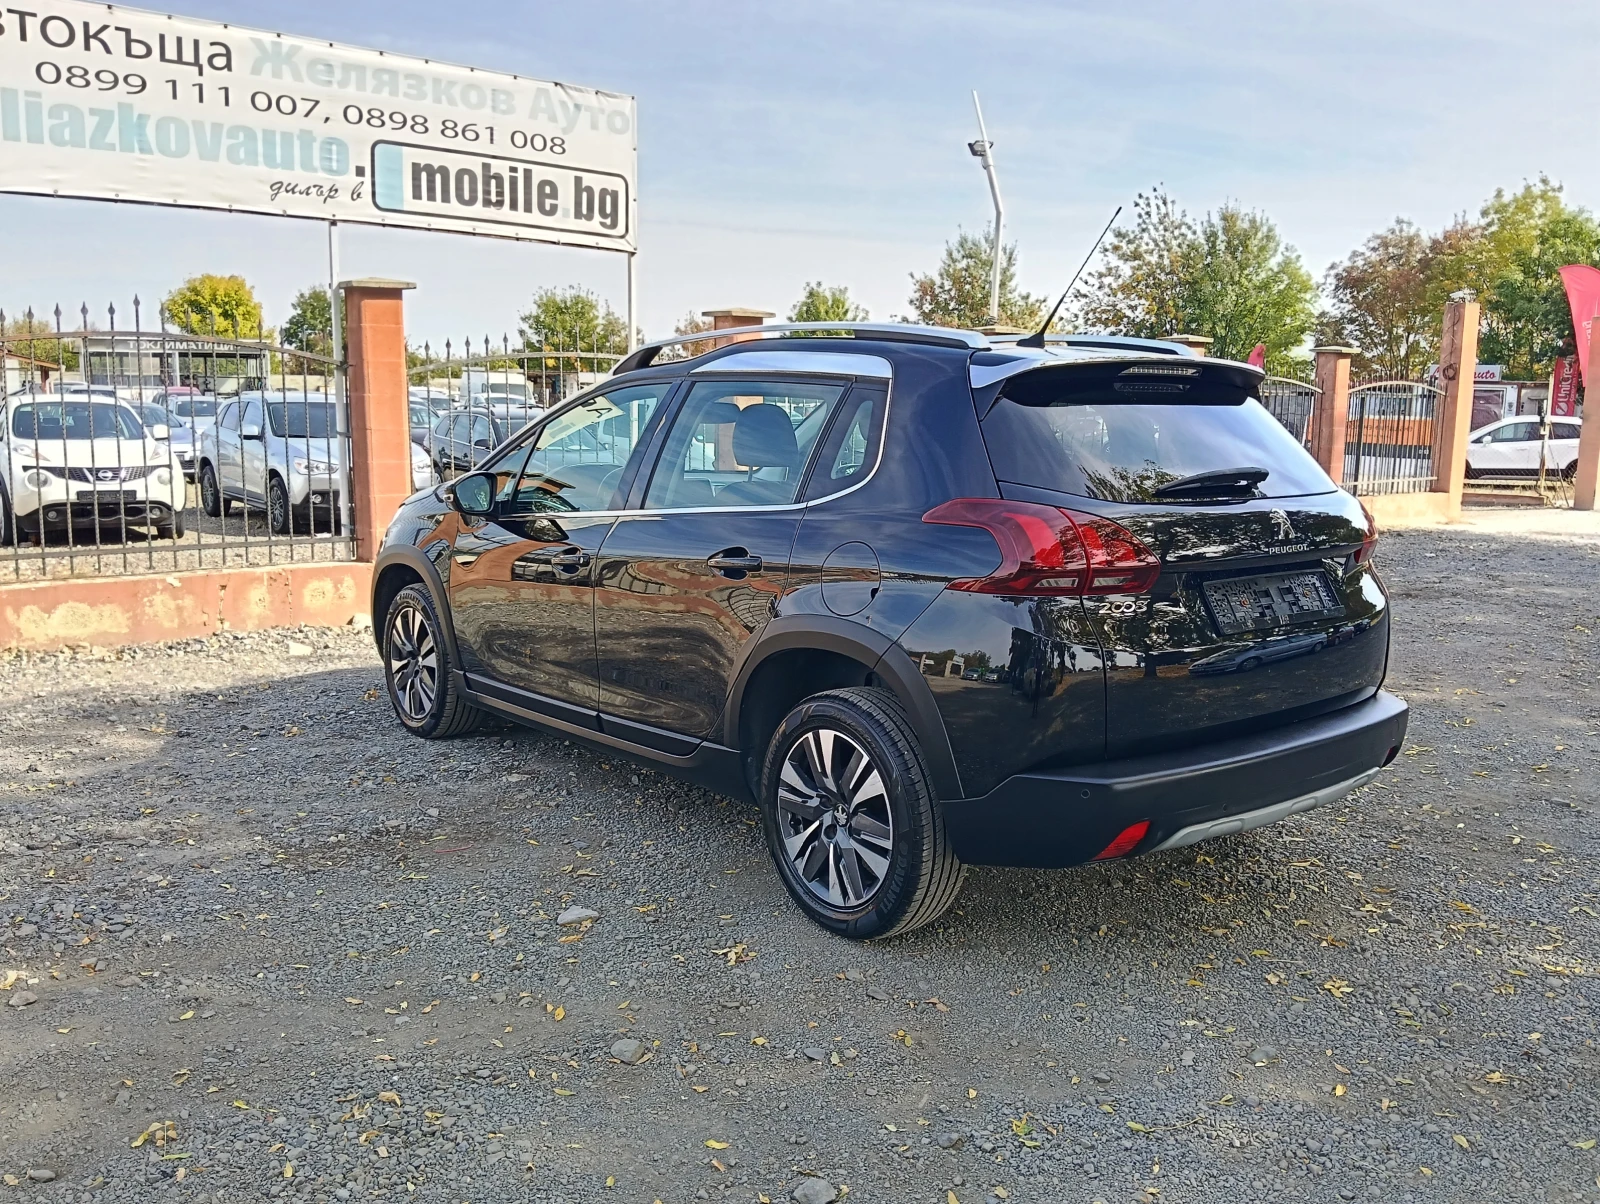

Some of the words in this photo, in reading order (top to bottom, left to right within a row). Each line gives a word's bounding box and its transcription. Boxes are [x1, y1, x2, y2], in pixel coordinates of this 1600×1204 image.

[0, 8, 233, 76] токъща
[250, 37, 516, 115] Желязков
[528, 87, 630, 135] Ауто
[35, 61, 147, 94] 0899
[165, 79, 230, 107] 111
[250, 91, 330, 123] 007,
[343, 105, 429, 134] 0898
[440, 119, 495, 144] 861
[510, 130, 566, 155] 008
[270, 181, 339, 204] дилър
[411, 161, 619, 230] mobile.bg
[1269, 543, 1308, 555] PEUGEOT
[1099, 598, 1149, 614] 2008
[880, 856, 909, 915] DAVANTI
